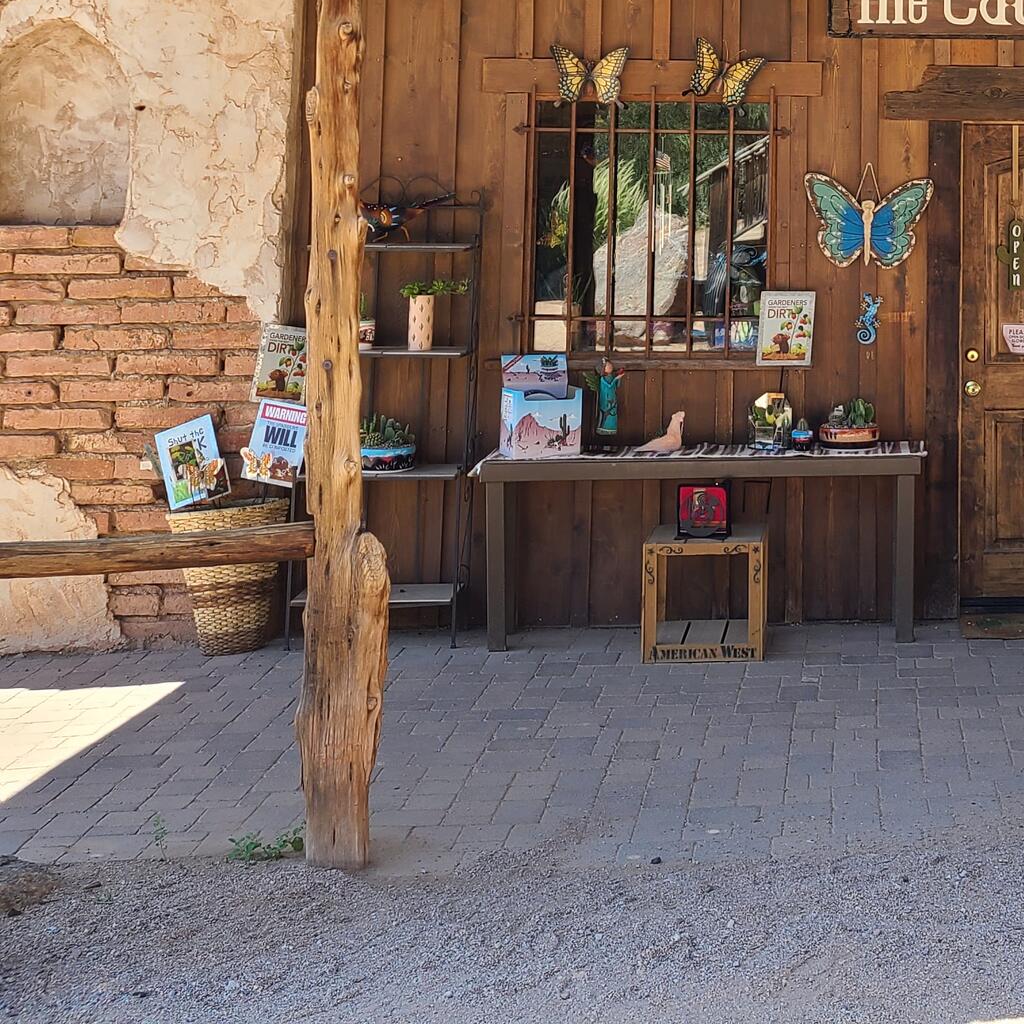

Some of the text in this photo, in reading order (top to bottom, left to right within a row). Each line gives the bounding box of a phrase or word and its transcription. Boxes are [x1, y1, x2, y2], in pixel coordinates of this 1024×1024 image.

[1012, 225, 1021, 287] OPEN
[270, 332, 307, 342] GARDENER
[265, 406, 307, 424] WARNING
[168, 433, 187, 446] Shut
[190, 428, 204, 438] the
[264, 425, 298, 448] WILL
[648, 645, 757, 661] AMERICAN WEST
